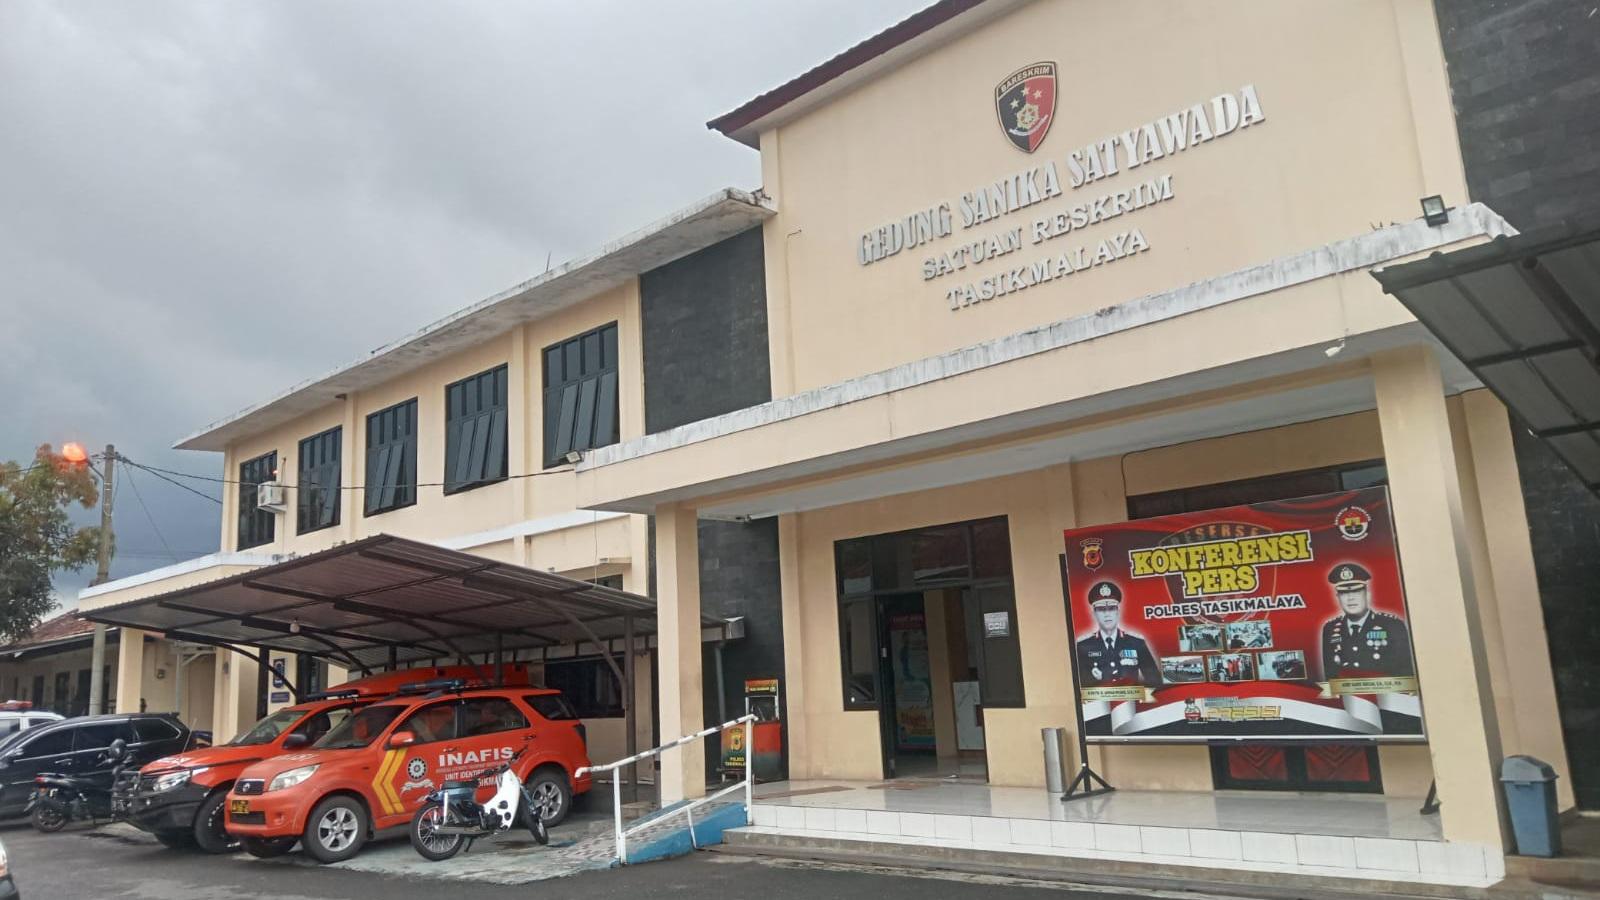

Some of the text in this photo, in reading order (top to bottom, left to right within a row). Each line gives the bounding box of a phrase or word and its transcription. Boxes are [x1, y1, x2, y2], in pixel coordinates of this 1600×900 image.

[1001, 66, 1050, 93] BARESKRIM
[857, 83, 1266, 267] GEDUNG SANIKA SATYAWADA
[921, 174, 1175, 282] SATUAN RESKRIM
[945, 227, 1150, 311] TASIKMALAYA
[1130, 531, 1312, 577] KONFERENSI
[1184, 564, 1258, 597] PERS
[1145, 595, 1305, 619] POLRES TASIKMALAYA
[438, 746, 514, 767] INAFIS
[445, 772, 459, 781] UNIT
